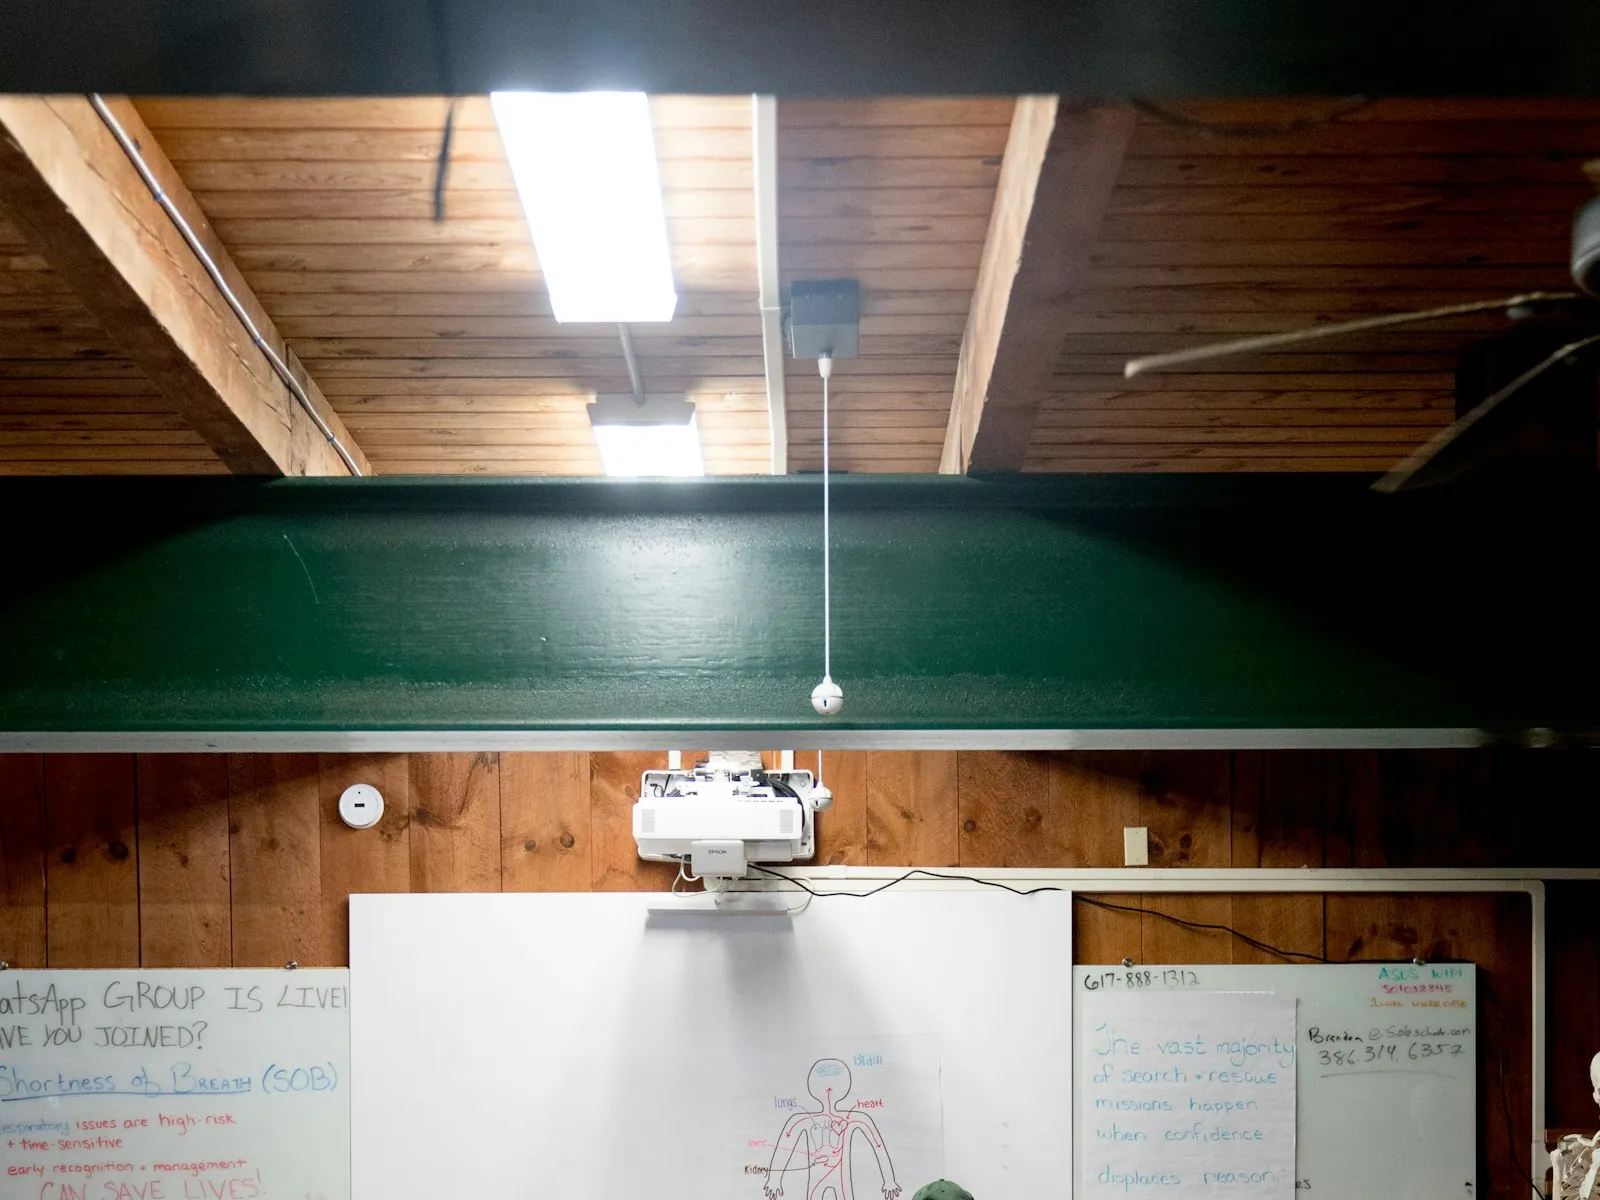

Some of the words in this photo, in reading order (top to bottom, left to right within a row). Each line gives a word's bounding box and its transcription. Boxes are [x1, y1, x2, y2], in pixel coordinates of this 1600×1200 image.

[1084, 970, 1201, 991] 617-888-1312
[104, 981, 205, 1012] GROUP
[224, 986, 263, 1012] IS
[43, 1024, 82, 1047] YOU
[95, 1020, 208, 1050] JOINED?
[1094, 1022, 1141, 1056] The
[1157, 1033, 1207, 1056] vast
[1216, 1037, 1296, 1068] majority
[131, 1065, 161, 1098] of
[261, 1061, 338, 1094] (SOB)
[1092, 1064, 1112, 1084] of
[1122, 1067, 1187, 1084] search
[1208, 1071, 1277, 1084] rescue
[774, 1096, 798, 1110] lungs
[857, 1098, 884, 1109] heart
[1096, 1099, 1172, 1111] missions
[1189, 1097, 1258, 1113] happen
[76, 1118, 117, 1131] issues
[123, 1118, 148, 1130] are
[1096, 1122, 1147, 1141] when
[1164, 1121, 1264, 1142] confidence
[20, 1136, 123, 1151] time-sensitive
[7, 1163, 45, 1178] early
[53, 1161, 133, 1178] recognition
[153, 1158, 247, 1177] management
[1097, 1165, 1181, 1192] displaces
[184, 1167, 267, 1200] LIVES!
